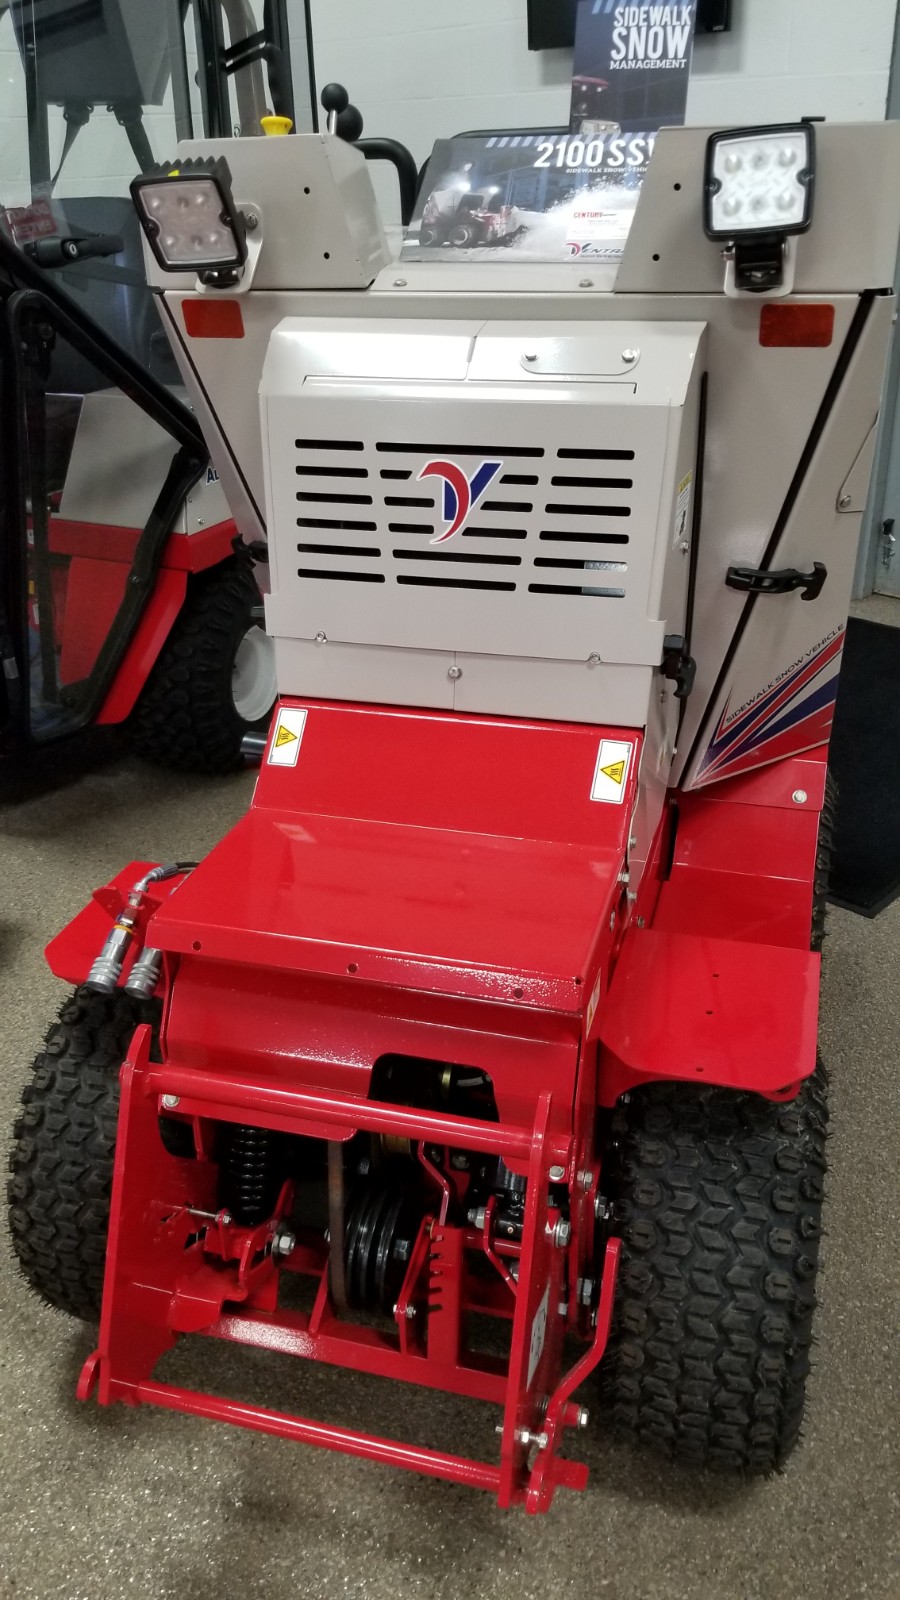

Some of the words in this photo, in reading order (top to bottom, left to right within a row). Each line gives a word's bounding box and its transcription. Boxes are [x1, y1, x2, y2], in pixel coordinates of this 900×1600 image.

[613, 5, 692, 28] SIDEWALK
[610, 25, 690, 60] SNOW
[609, 59, 687, 70] MANAGEMENT
[533, 140, 604, 167] 2100
[726, 683, 775, 724] SIDEWALK
[775, 656, 804, 684] SNOW
[805, 623, 844, 657] VEHICLE
